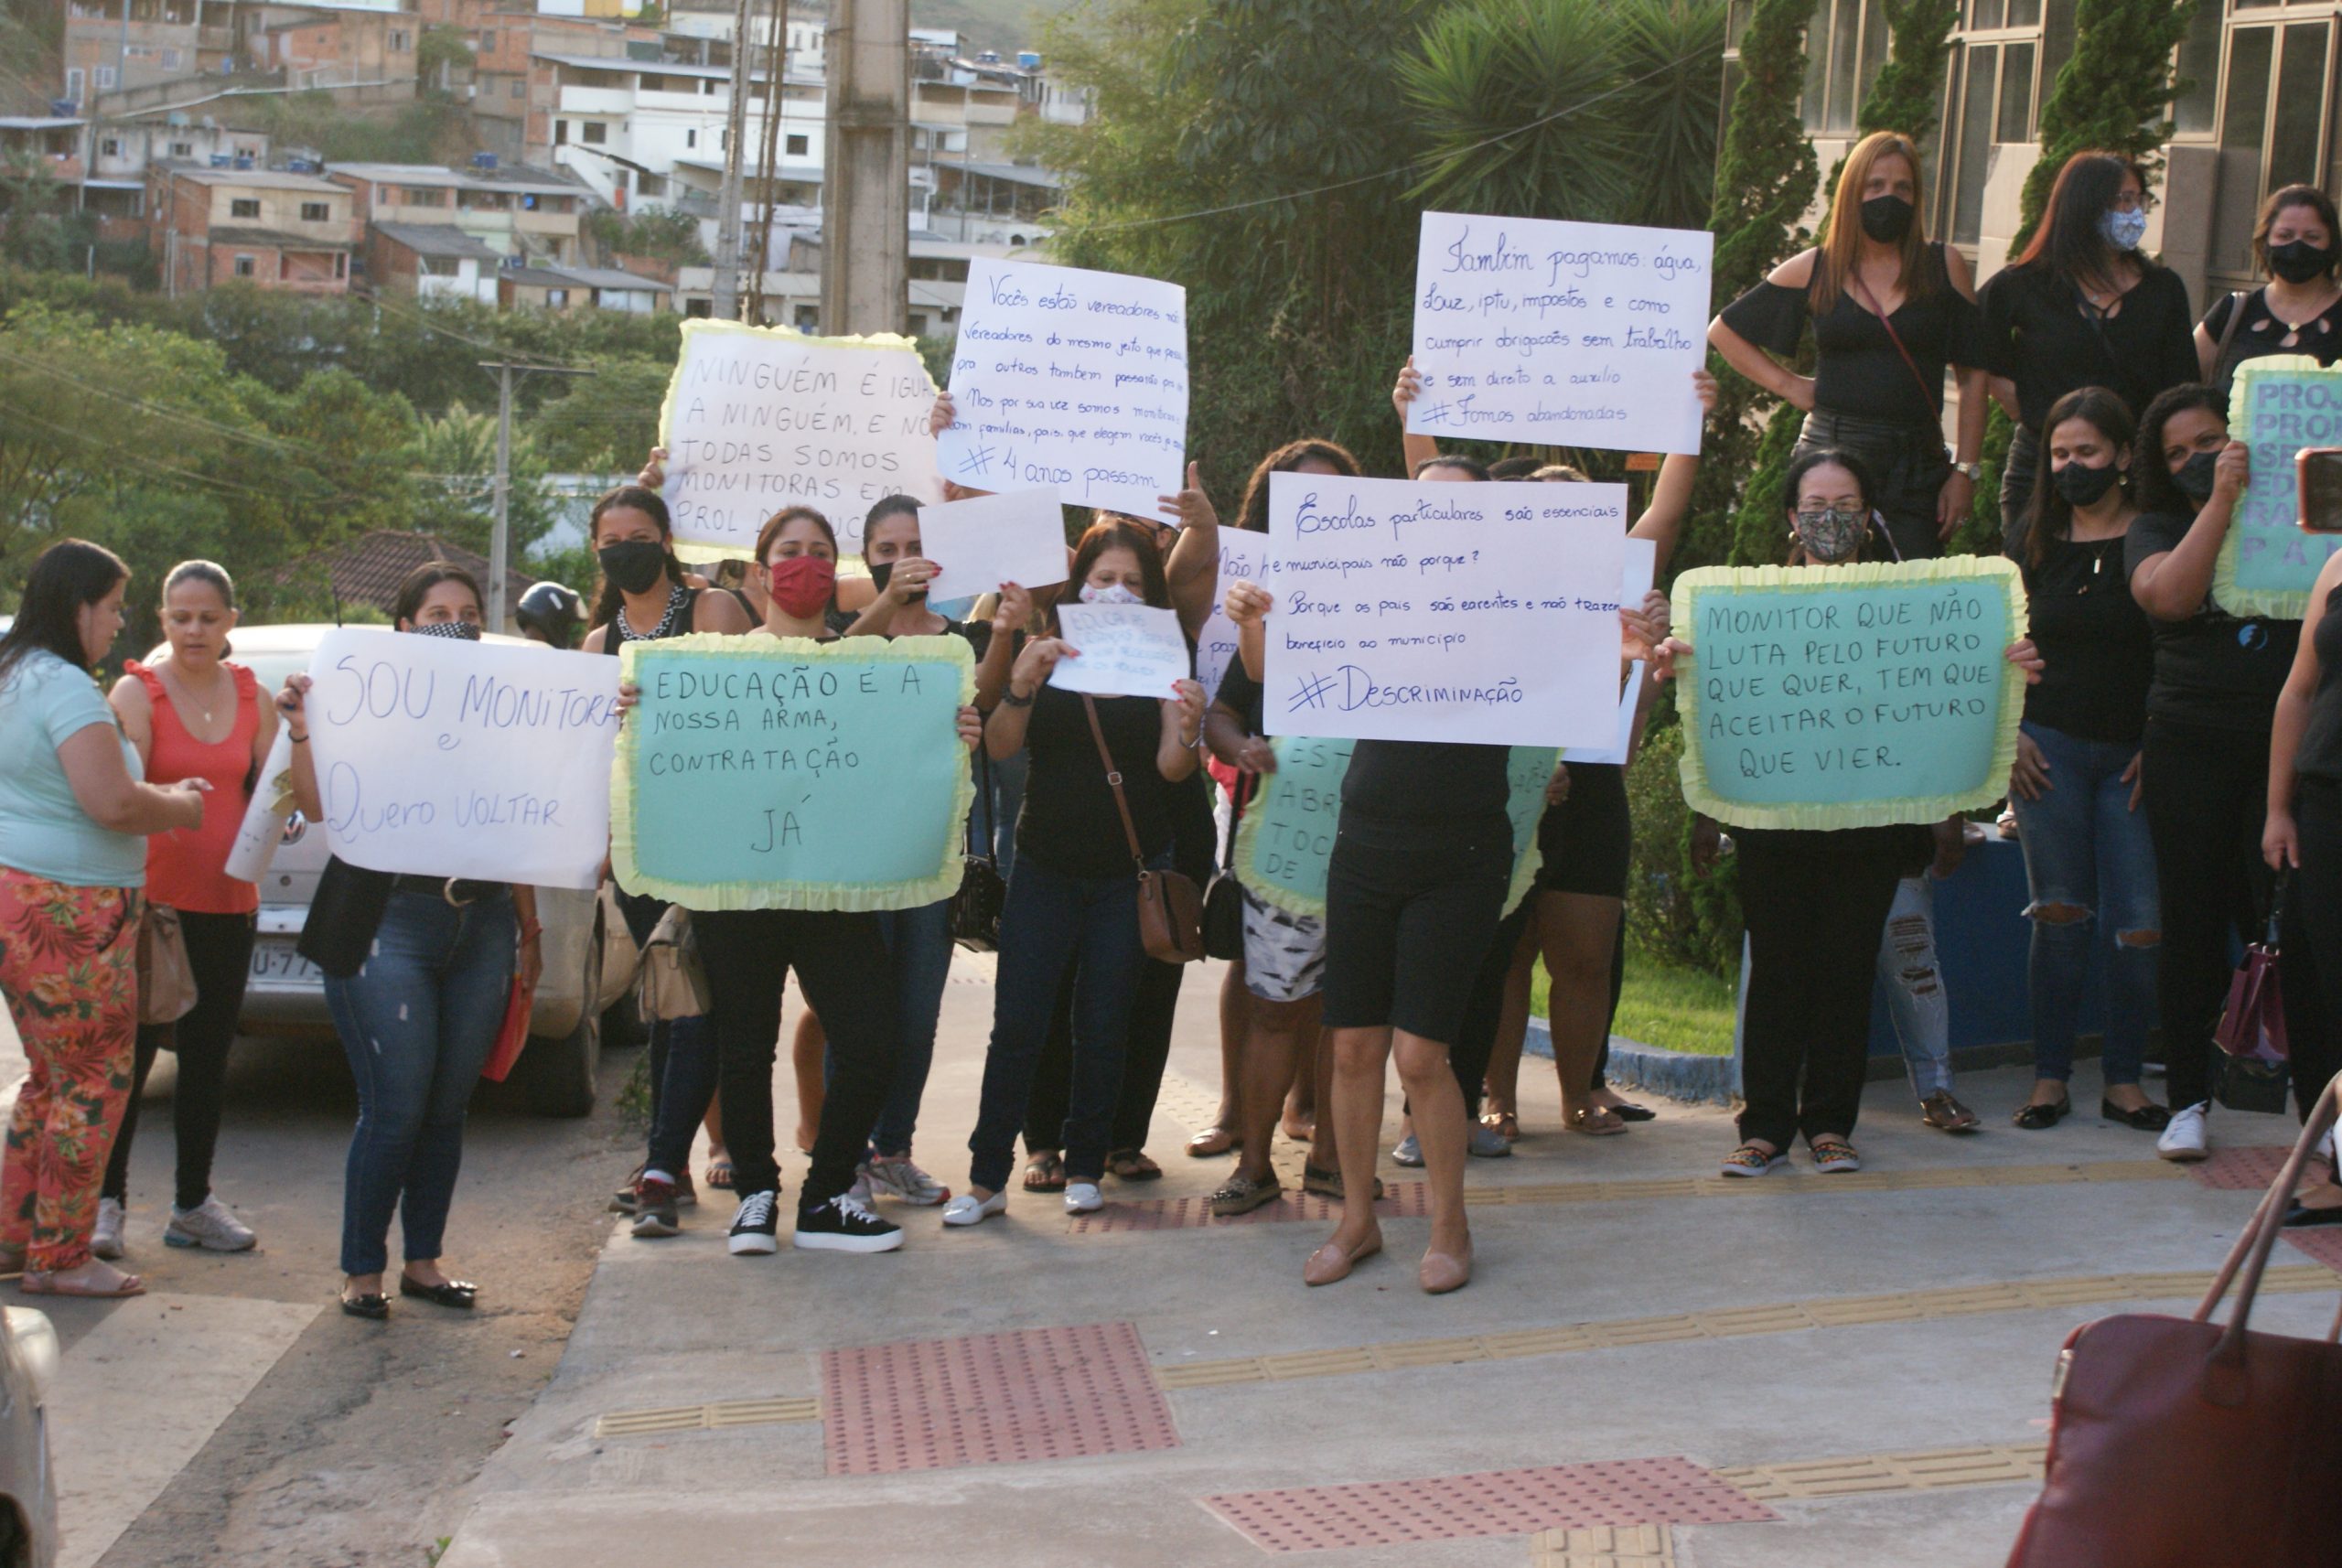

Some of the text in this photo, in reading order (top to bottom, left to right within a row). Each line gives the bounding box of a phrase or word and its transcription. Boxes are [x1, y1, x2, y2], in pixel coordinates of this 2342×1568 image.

[1654, 245, 1702, 281] água,
[989, 274, 1028, 306] Vocês
[1038, 284, 1078, 309] estão
[1088, 300, 1159, 319] vereadores
[1522, 285, 1587, 320] impostos
[1605, 297, 1615, 308] e
[1628, 299, 1671, 314] como
[1047, 332, 1061, 346] do
[1068, 339, 1112, 349] mesmo
[1116, 337, 1141, 356] jeito
[1146, 347, 1162, 360] que
[1425, 336, 1483, 358] cumprir
[1582, 335, 1614, 348] sem
[1623, 326, 1692, 349] trabalho
[691, 357, 837, 393] NINGUÉM
[860, 361, 878, 396] É
[1424, 375, 1434, 386] e
[1447, 373, 1476, 387] sem
[1487, 365, 1531, 386] direito
[1543, 374, 1556, 386] a
[686, 397, 705, 424] A
[1000, 398, 1019, 416] por
[1026, 398, 1045, 409] sua
[1050, 399, 1069, 411] vez
[1078, 403, 1120, 413] somos
[1527, 401, 1627, 422] abandonadas
[1068, 431, 1085, 443] que
[682, 440, 899, 471] TODAS SOMOS
[675, 472, 841, 499] MONITORAS
[1025, 463, 1072, 483] anos
[677, 500, 737, 532] PROL
[1295, 493, 1376, 541] Escolas
[1389, 496, 1484, 541] particulares
[1542, 505, 1619, 519] essenciais
[1219, 546, 1252, 577] Não
[1273, 561, 1282, 573] e
[1380, 554, 1408, 568] não
[1355, 604, 1370, 614] os
[1380, 598, 1411, 618] pais
[1430, 596, 1455, 613] são
[1525, 602, 1533, 610] e
[1706, 588, 1982, 637] MONITOR QUE NÃO
[1359, 639, 1377, 650] ao
[1707, 634, 1980, 670] LUTA PELO FUTURO
[328, 654, 435, 725] SOU
[656, 665, 921, 708] EDUCAÇÃO É A
[1707, 663, 1992, 703] QUE QUER, TEM QUE
[653, 708, 838, 735] NOSSA ARMA,
[1709, 698, 1986, 739] ACEITAR O FUTURO
[437, 733, 461, 750] e
[650, 737, 860, 779] CONTRATAÇÃO
[1740, 746, 1902, 779] QUE VIER.
[327, 761, 563, 843] Quero VOLTAR
[750, 794, 811, 854] JÁ
[1266, 853, 1298, 879] DE
